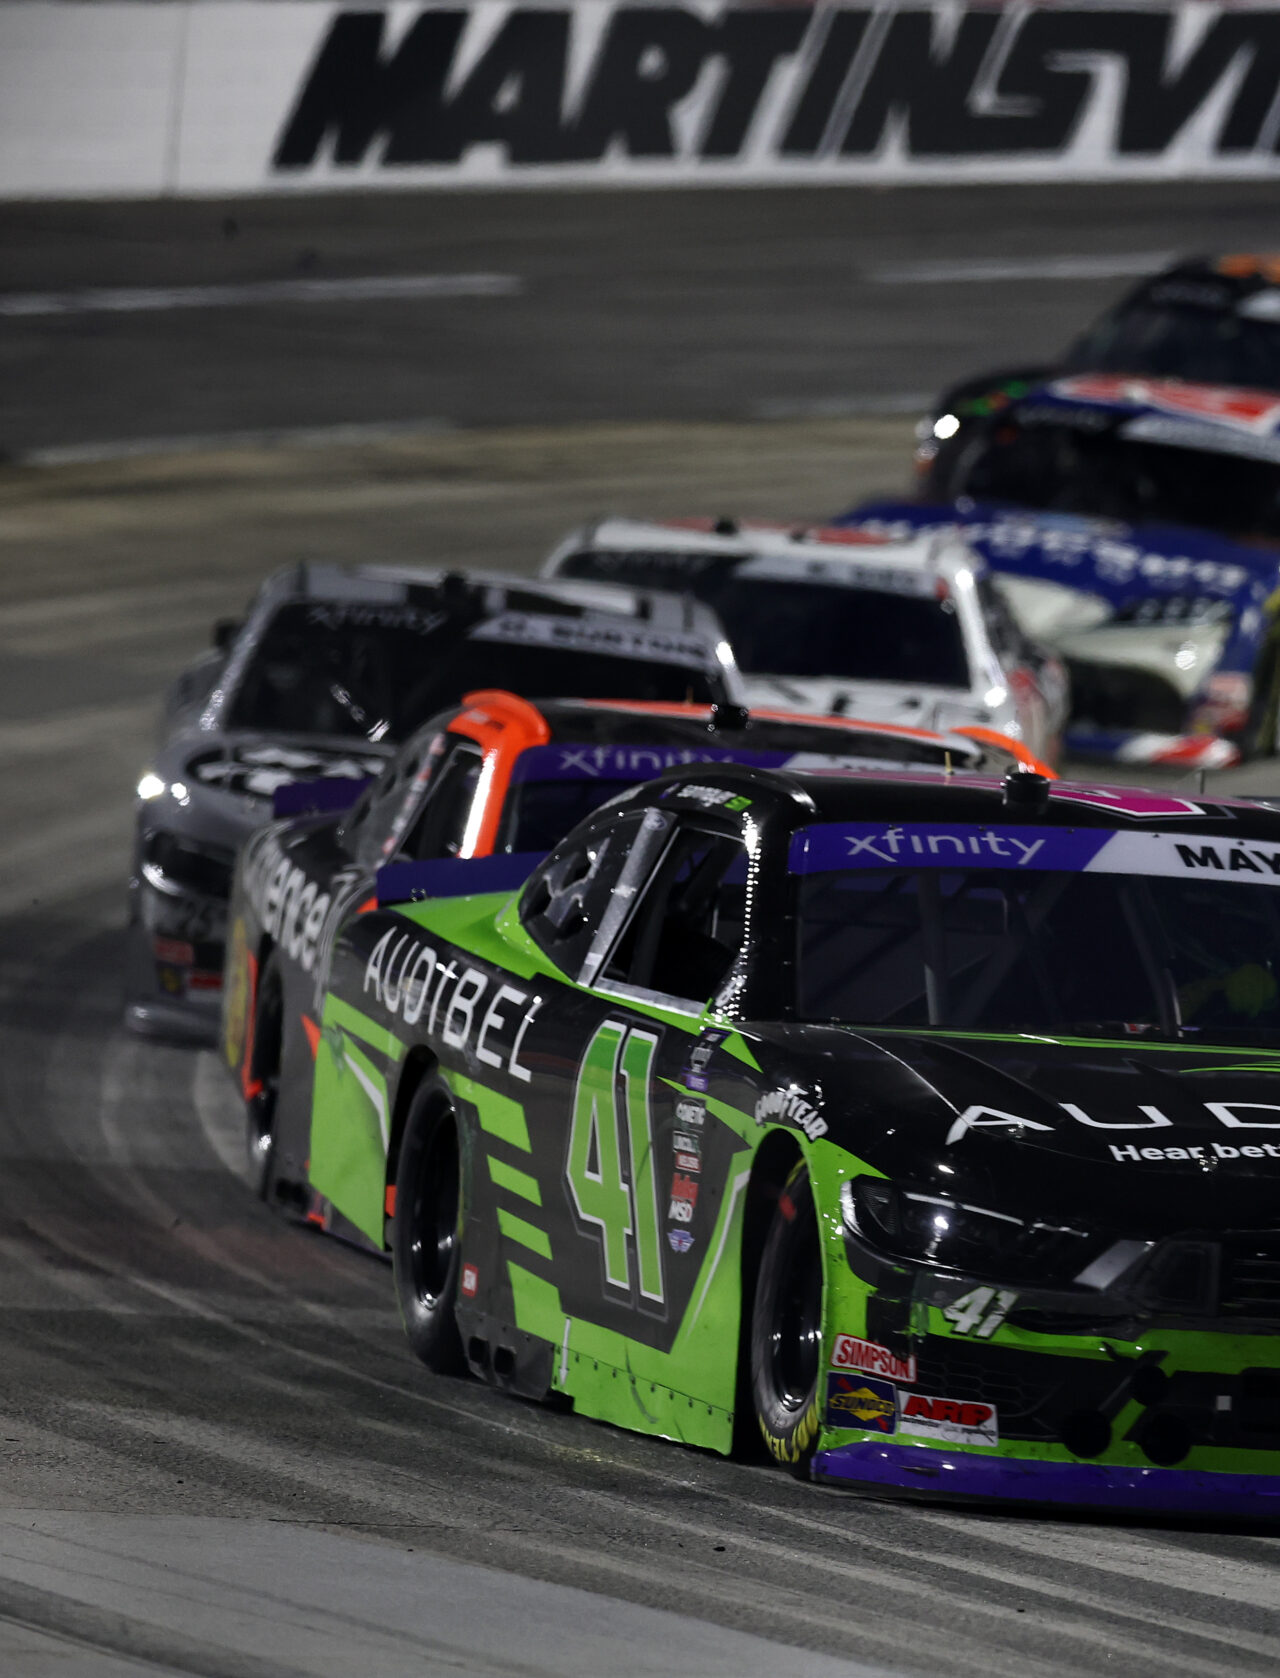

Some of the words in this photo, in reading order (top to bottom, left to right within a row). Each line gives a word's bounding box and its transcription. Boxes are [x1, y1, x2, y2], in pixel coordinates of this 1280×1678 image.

[844, 827, 1046, 865] xfinity
[363, 926, 542, 1082] AUDIBEL
[565, 1018, 665, 1304] 41
[1109, 1143, 1203, 1163] Hear
[943, 1286, 1018, 1338] 41
[836, 1339, 916, 1381] SIMPSON
[903, 1395, 994, 1427] ARP
